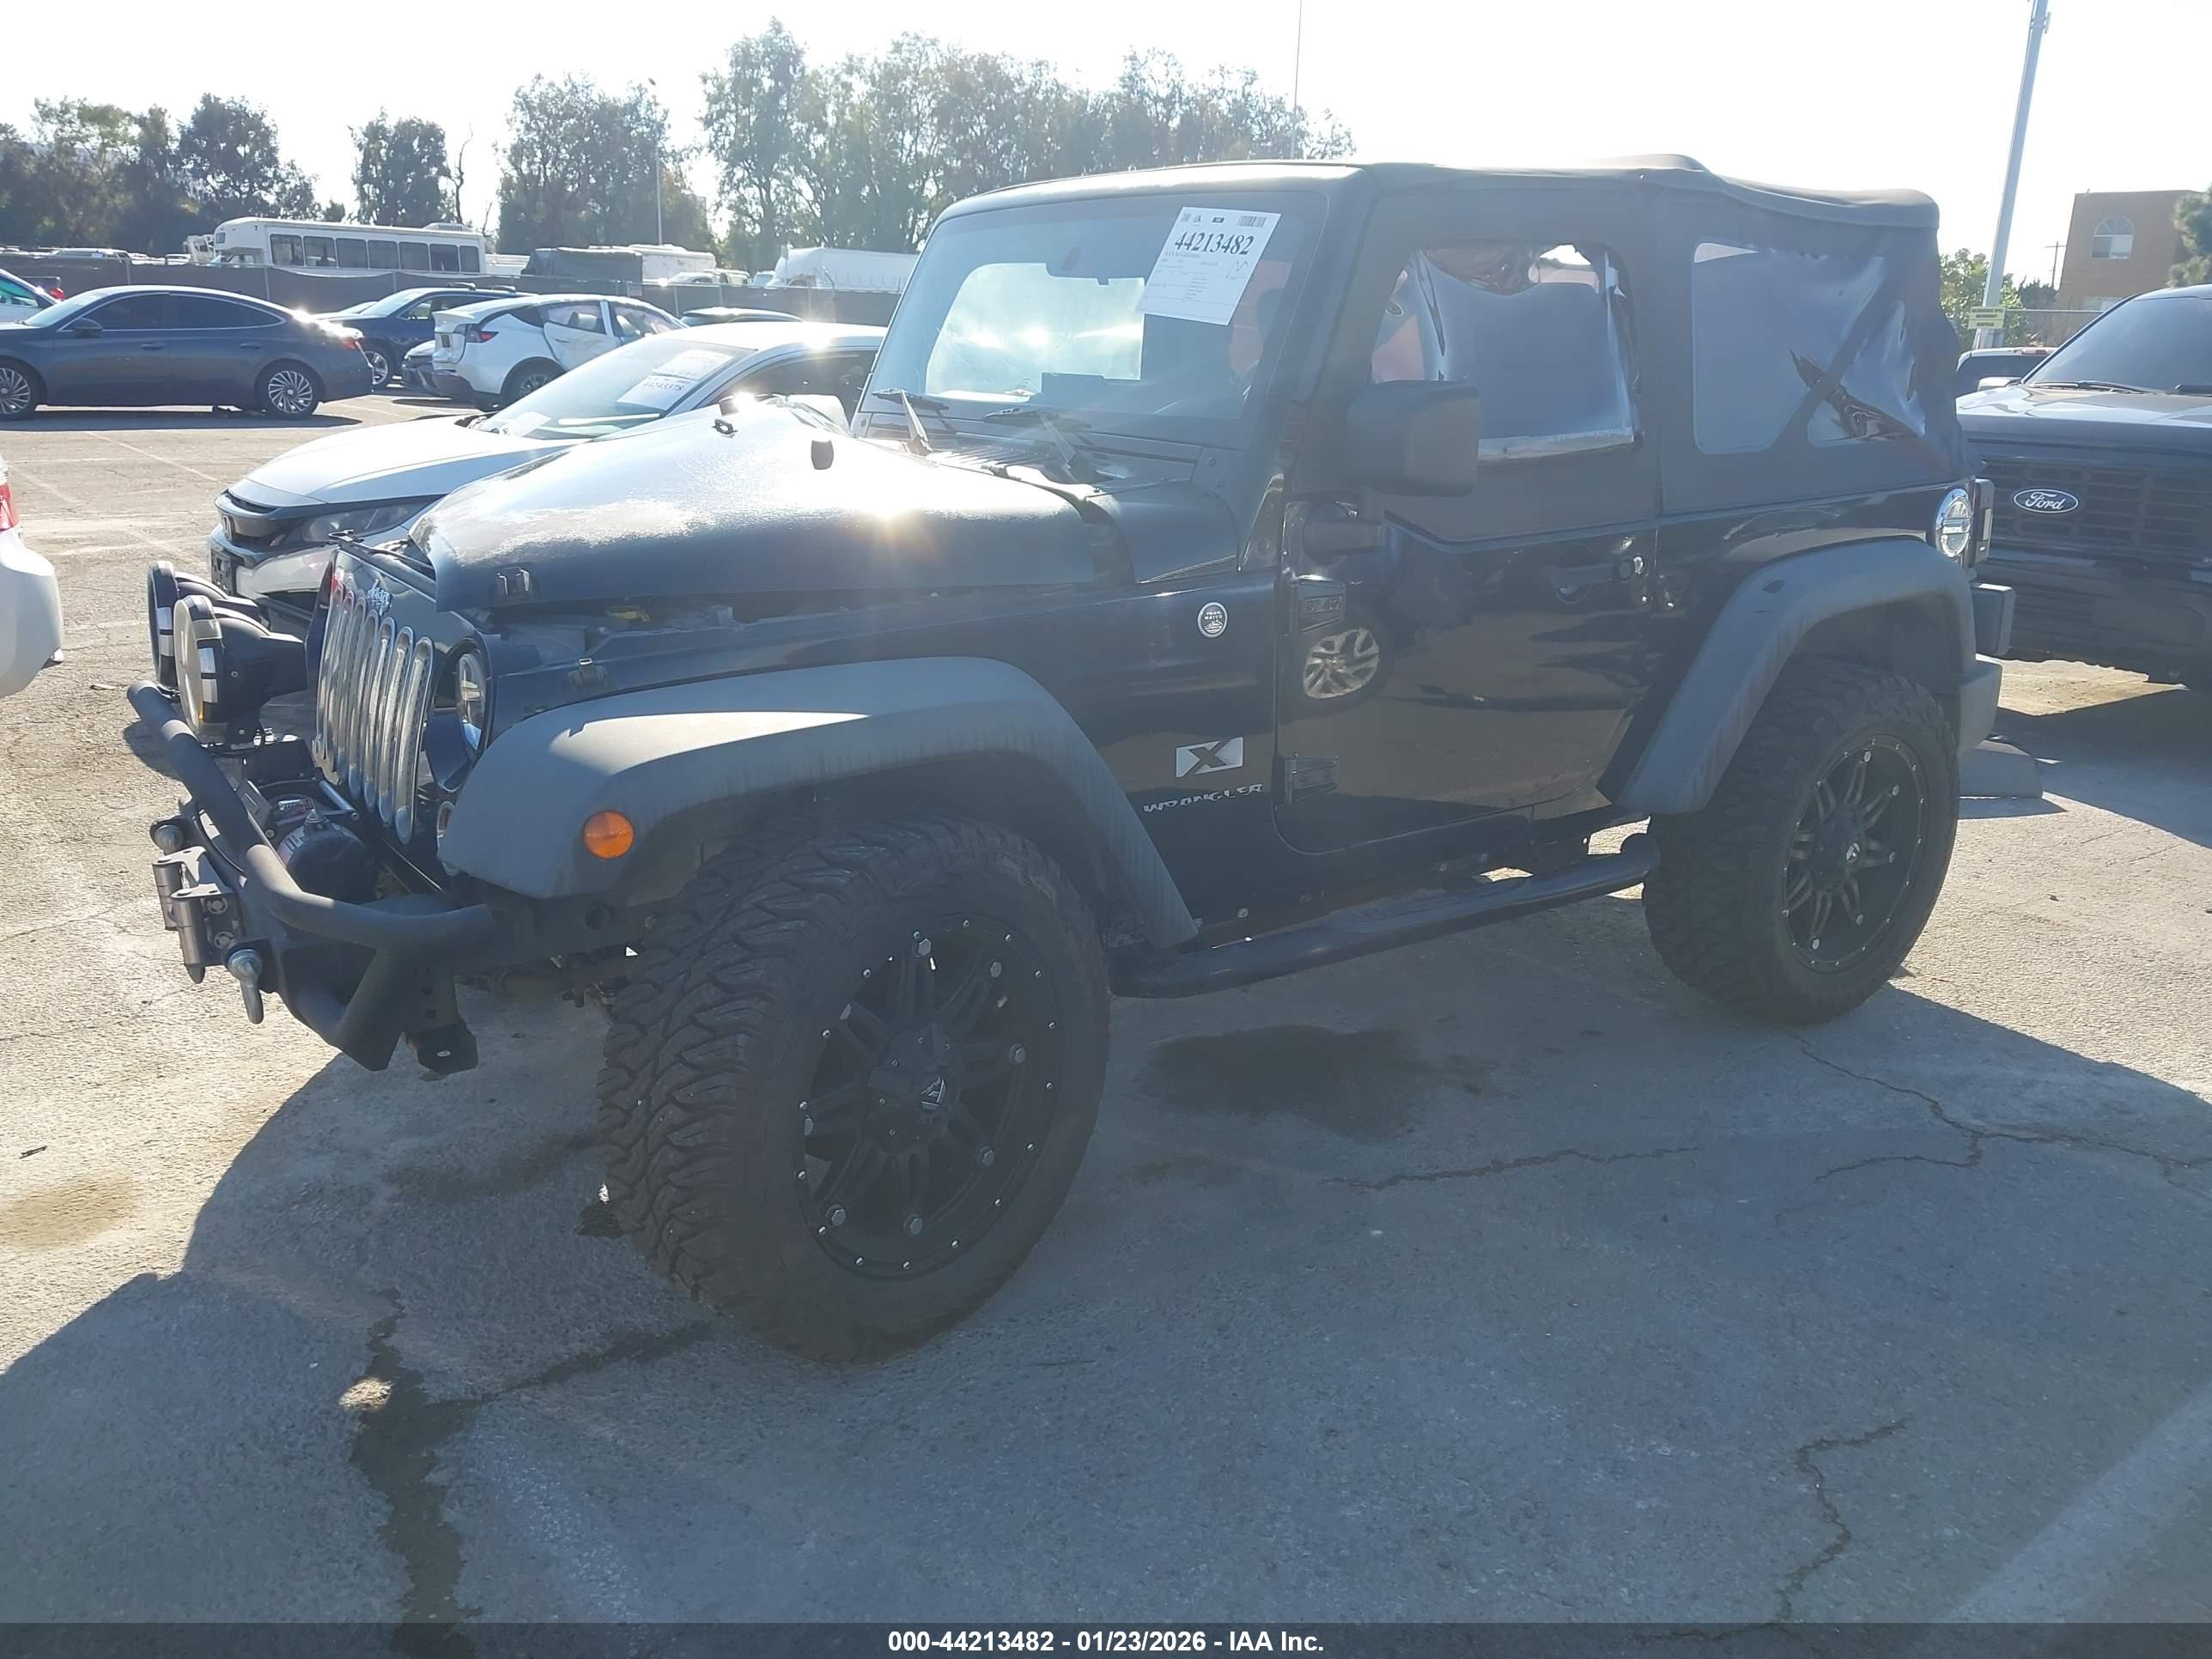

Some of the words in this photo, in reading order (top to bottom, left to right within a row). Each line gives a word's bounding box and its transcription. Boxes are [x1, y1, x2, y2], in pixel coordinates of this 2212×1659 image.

[1174, 231, 1255, 256] 44213482
[2024, 491, 2067, 510] Ford
[1181, 738, 1235, 777] X
[1143, 783, 1264, 813] WRANGLER
